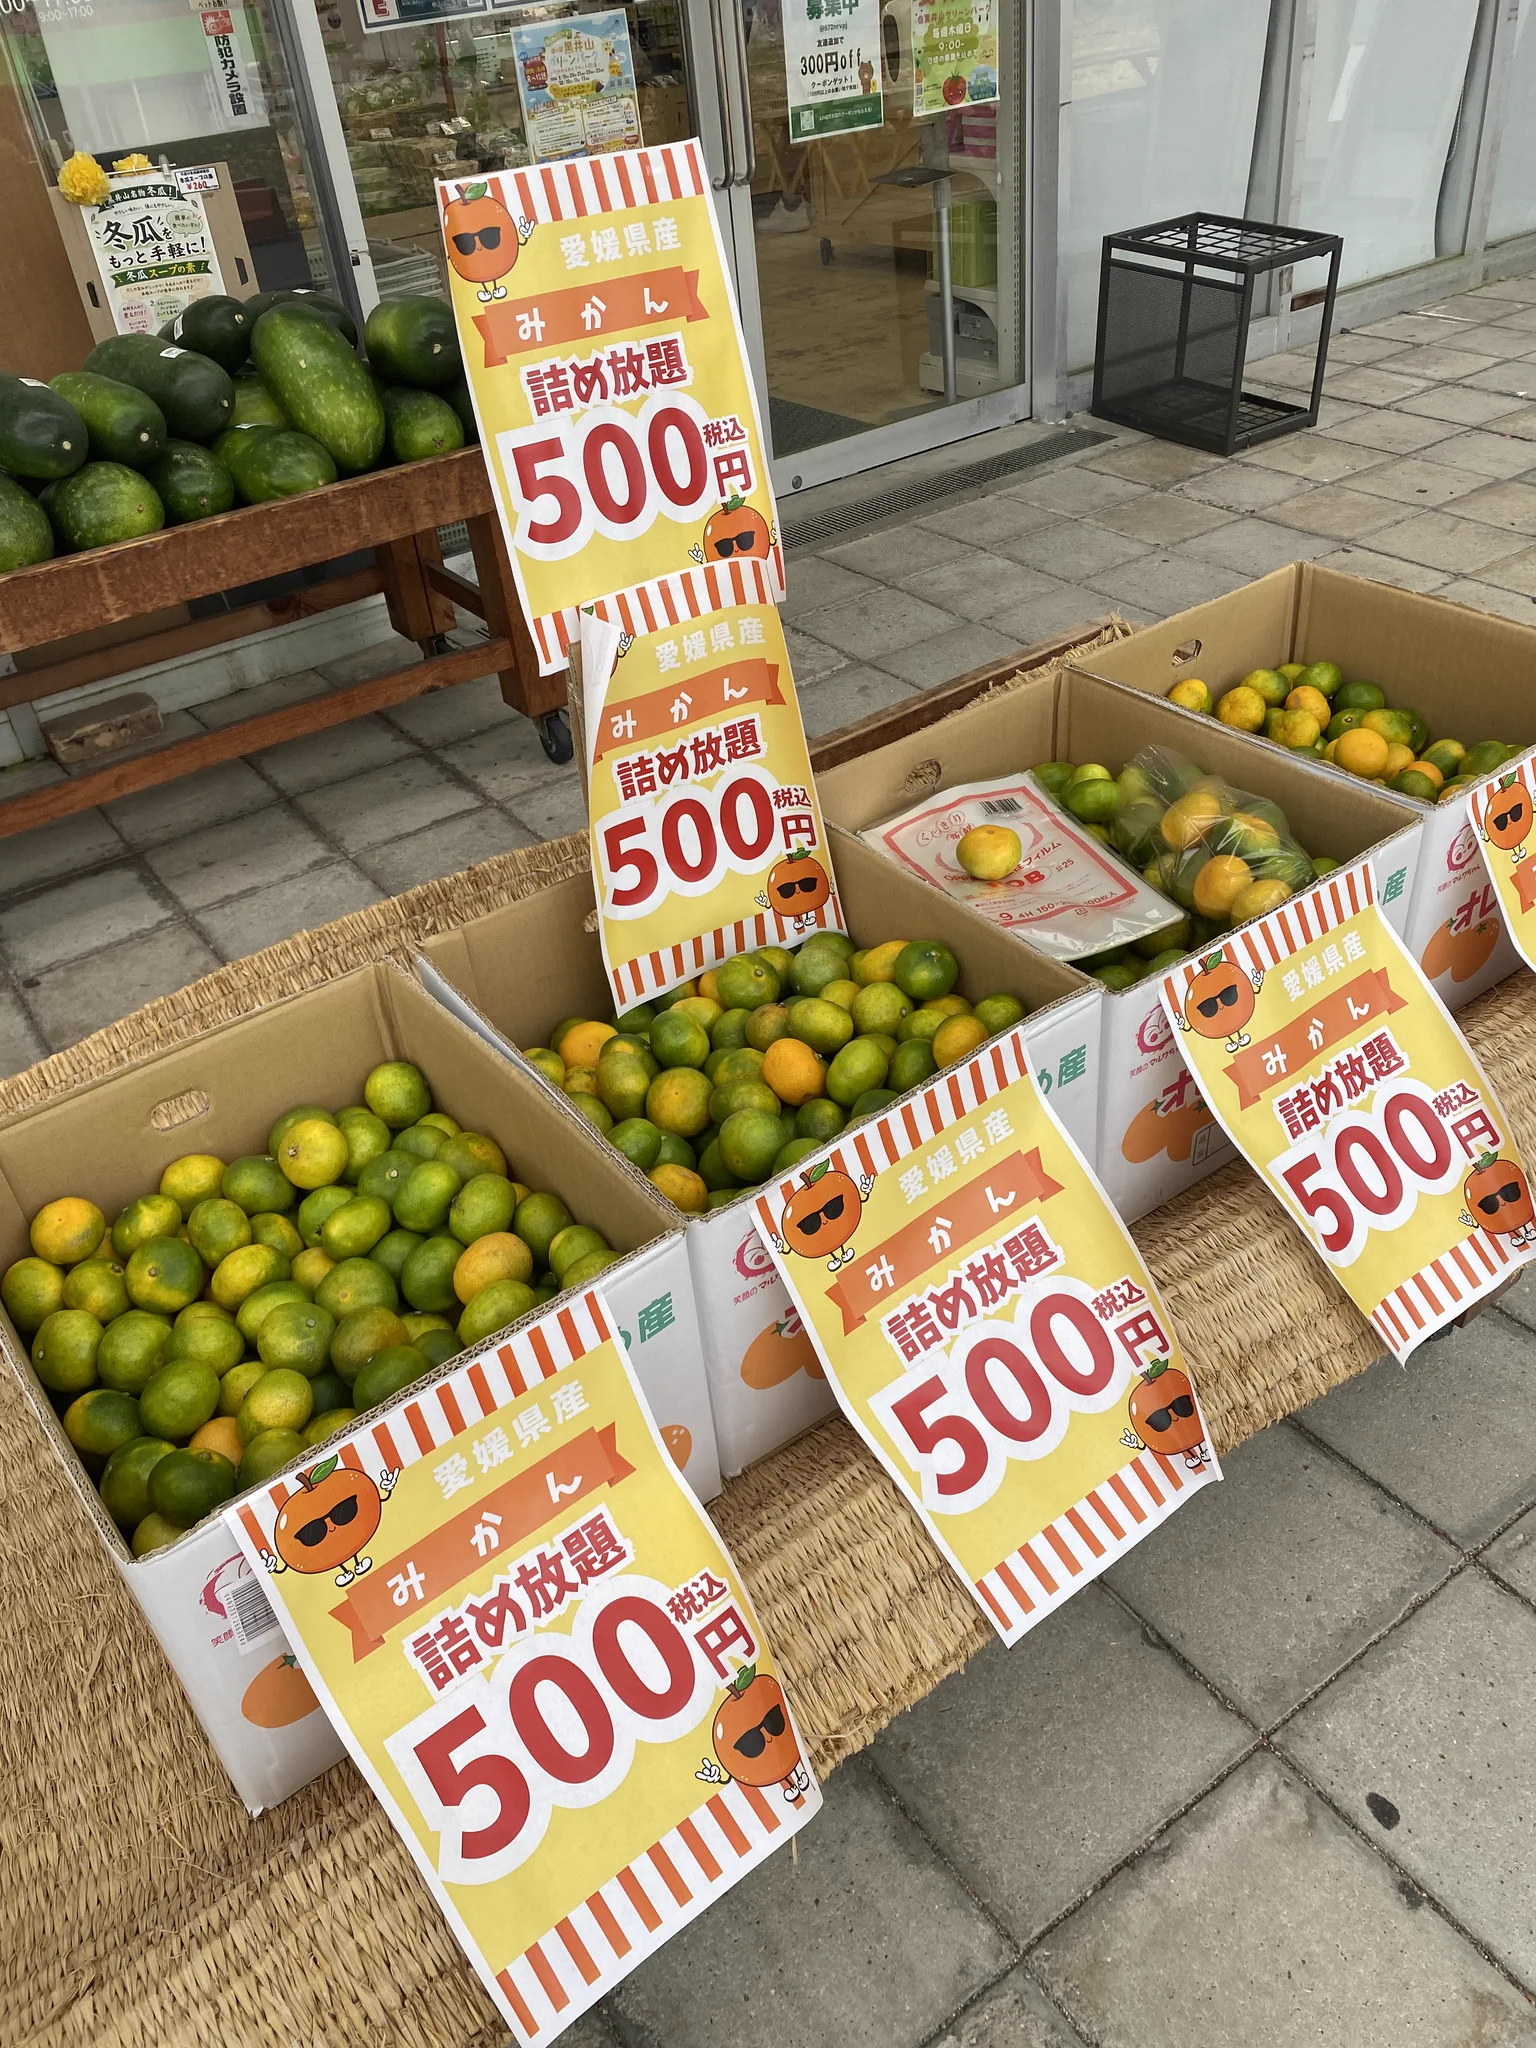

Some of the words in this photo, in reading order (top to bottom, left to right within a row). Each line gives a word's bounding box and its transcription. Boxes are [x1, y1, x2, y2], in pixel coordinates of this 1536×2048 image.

[801, 47, 861, 76] 300円off
[933, 22, 971, 39] 毎週木曜日
[214, 34, 248, 116] 防犯カメラ設置
[108, 236, 207, 269] もっと手軽に!
[126, 262, 196, 282] 冬瓜スープの素
[559, 216, 682, 271] 愛媛県産
[516, 286, 670, 343] みかん
[526, 338, 688, 417] 詰め放題
[703, 417, 746, 448] 税込
[655, 617, 766, 673] 愛媛県産
[610, 677, 749, 739] みかん
[617, 718, 761, 800] 詰め放題
[772, 787, 812, 809] 税込
[1282, 930, 1367, 1003] 愛媛県産
[1261, 996, 1371, 1075] みかん
[1278, 1032, 1405, 1140] 詰め放題
[1433, 1083, 1479, 1118] 税込
[898, 1107, 1014, 1204] 愛媛県産
[865, 1185, 1017, 1291] みかん
[889, 1222, 1058, 1361] 詰め放題
[1092, 1279, 1145, 1322] 税込
[432, 1379, 589, 1500] 愛媛県産
[386, 1470, 583, 1607] みかん
[413, 1512, 629, 1690] 詰め放題
[668, 1573, 728, 1625] 税込
